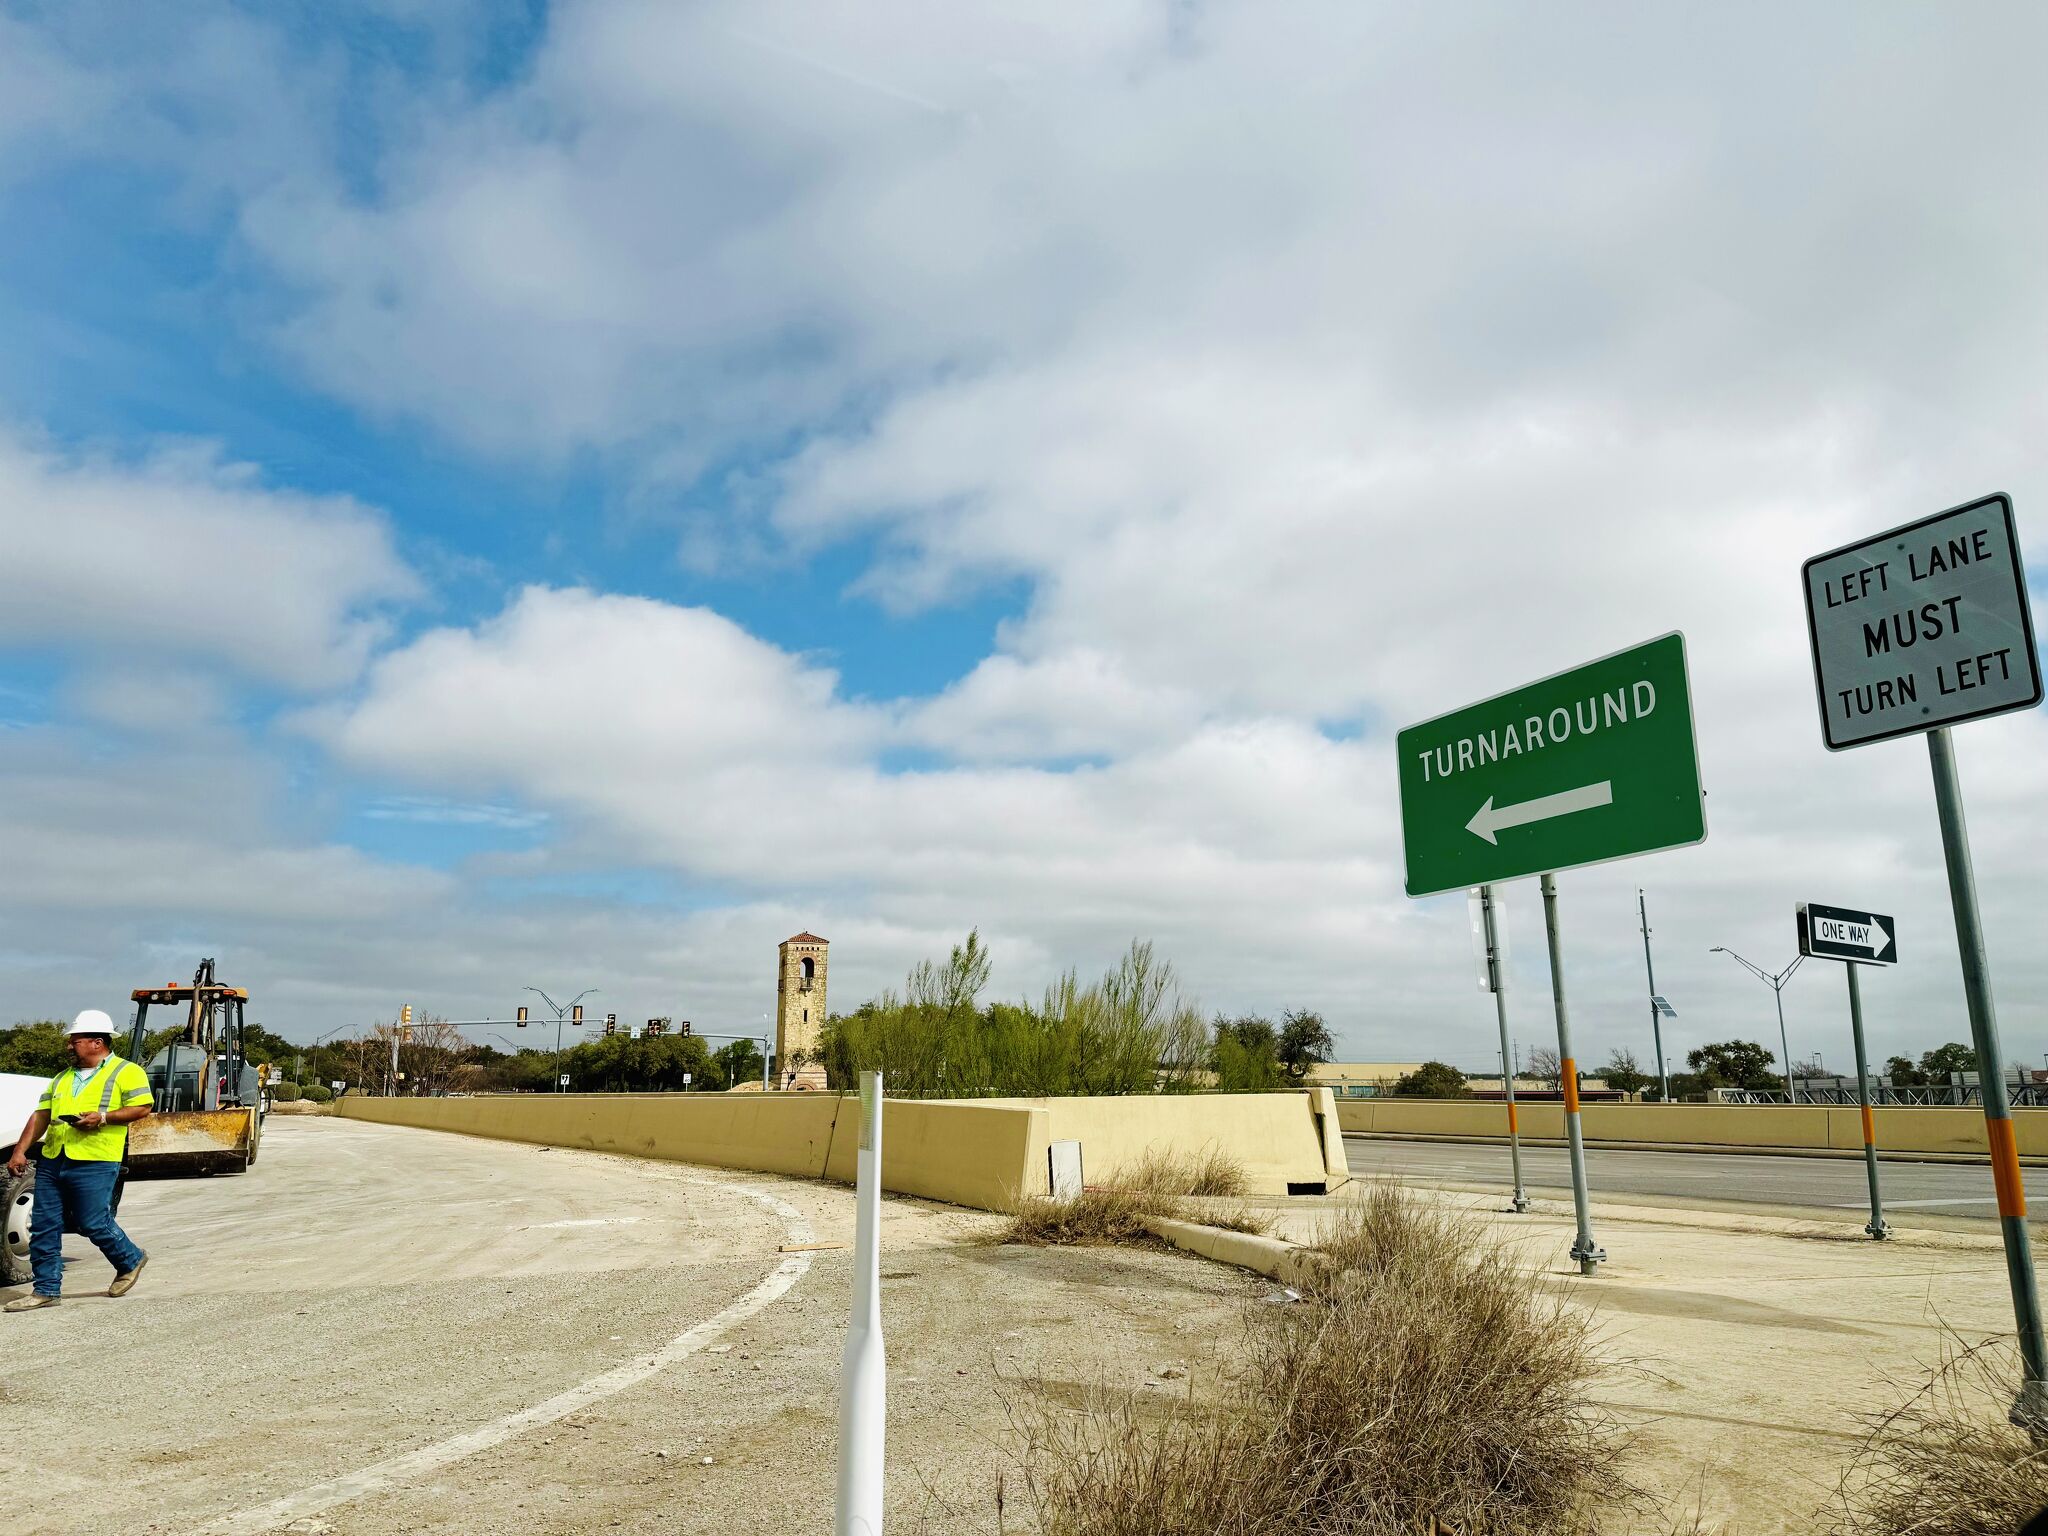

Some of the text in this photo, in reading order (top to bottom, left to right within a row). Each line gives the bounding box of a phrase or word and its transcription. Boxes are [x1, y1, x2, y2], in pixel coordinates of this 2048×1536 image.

[1824, 529, 1992, 608] LEFT LANE
[1863, 596, 1962, 657] MUST
[1838, 648, 2010, 719] TURN LEFT
[1419, 680, 1656, 782] TURNAROUND
[1822, 921, 1869, 943] ONE WAY
